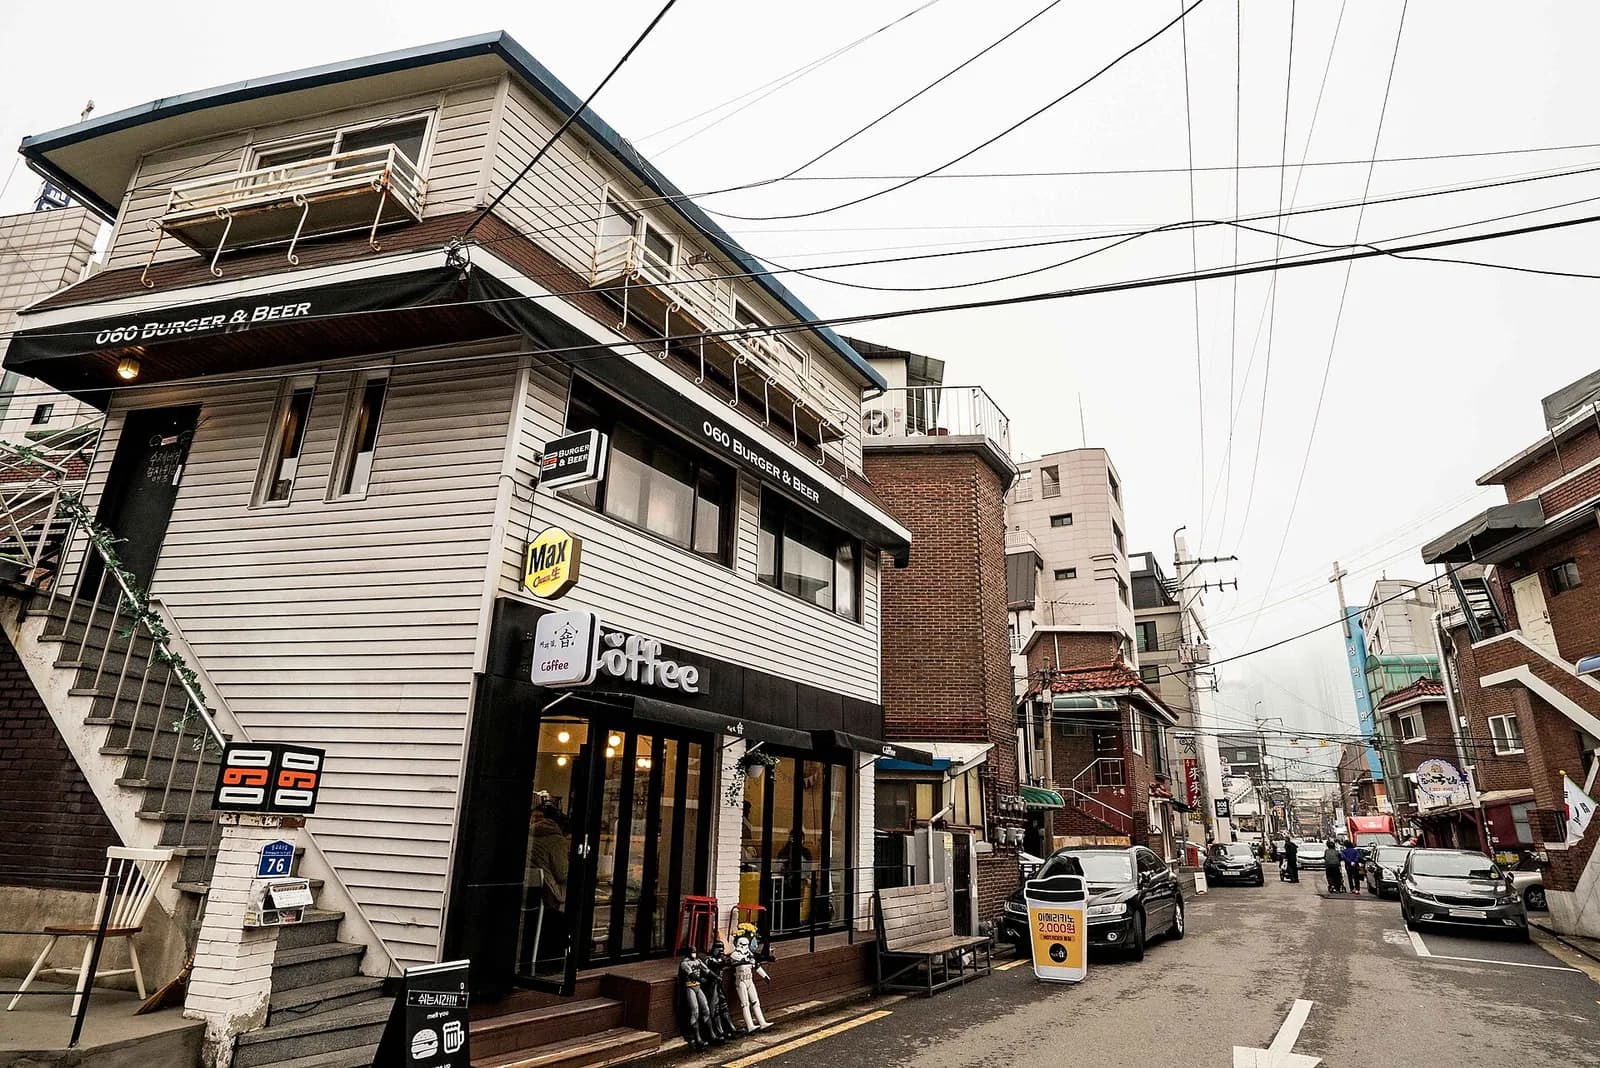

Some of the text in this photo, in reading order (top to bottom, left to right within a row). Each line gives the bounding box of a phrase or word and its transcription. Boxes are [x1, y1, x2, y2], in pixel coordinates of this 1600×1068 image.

[141, 314, 226, 339] BURGER
[229, 309, 249, 324] &
[251, 302, 312, 322] BEER
[558, 454, 589, 467] & BEER
[559, 444, 590, 458] BURGER
[703, 421, 820, 504] 060 BURGER & BEER
[528, 539, 568, 575] Max
[541, 659, 569, 672] Coffee
[598, 631, 699, 693] offee
[219, 749, 273, 805] 060
[274, 752, 320, 807] 060
[267, 858, 285, 873] 76
